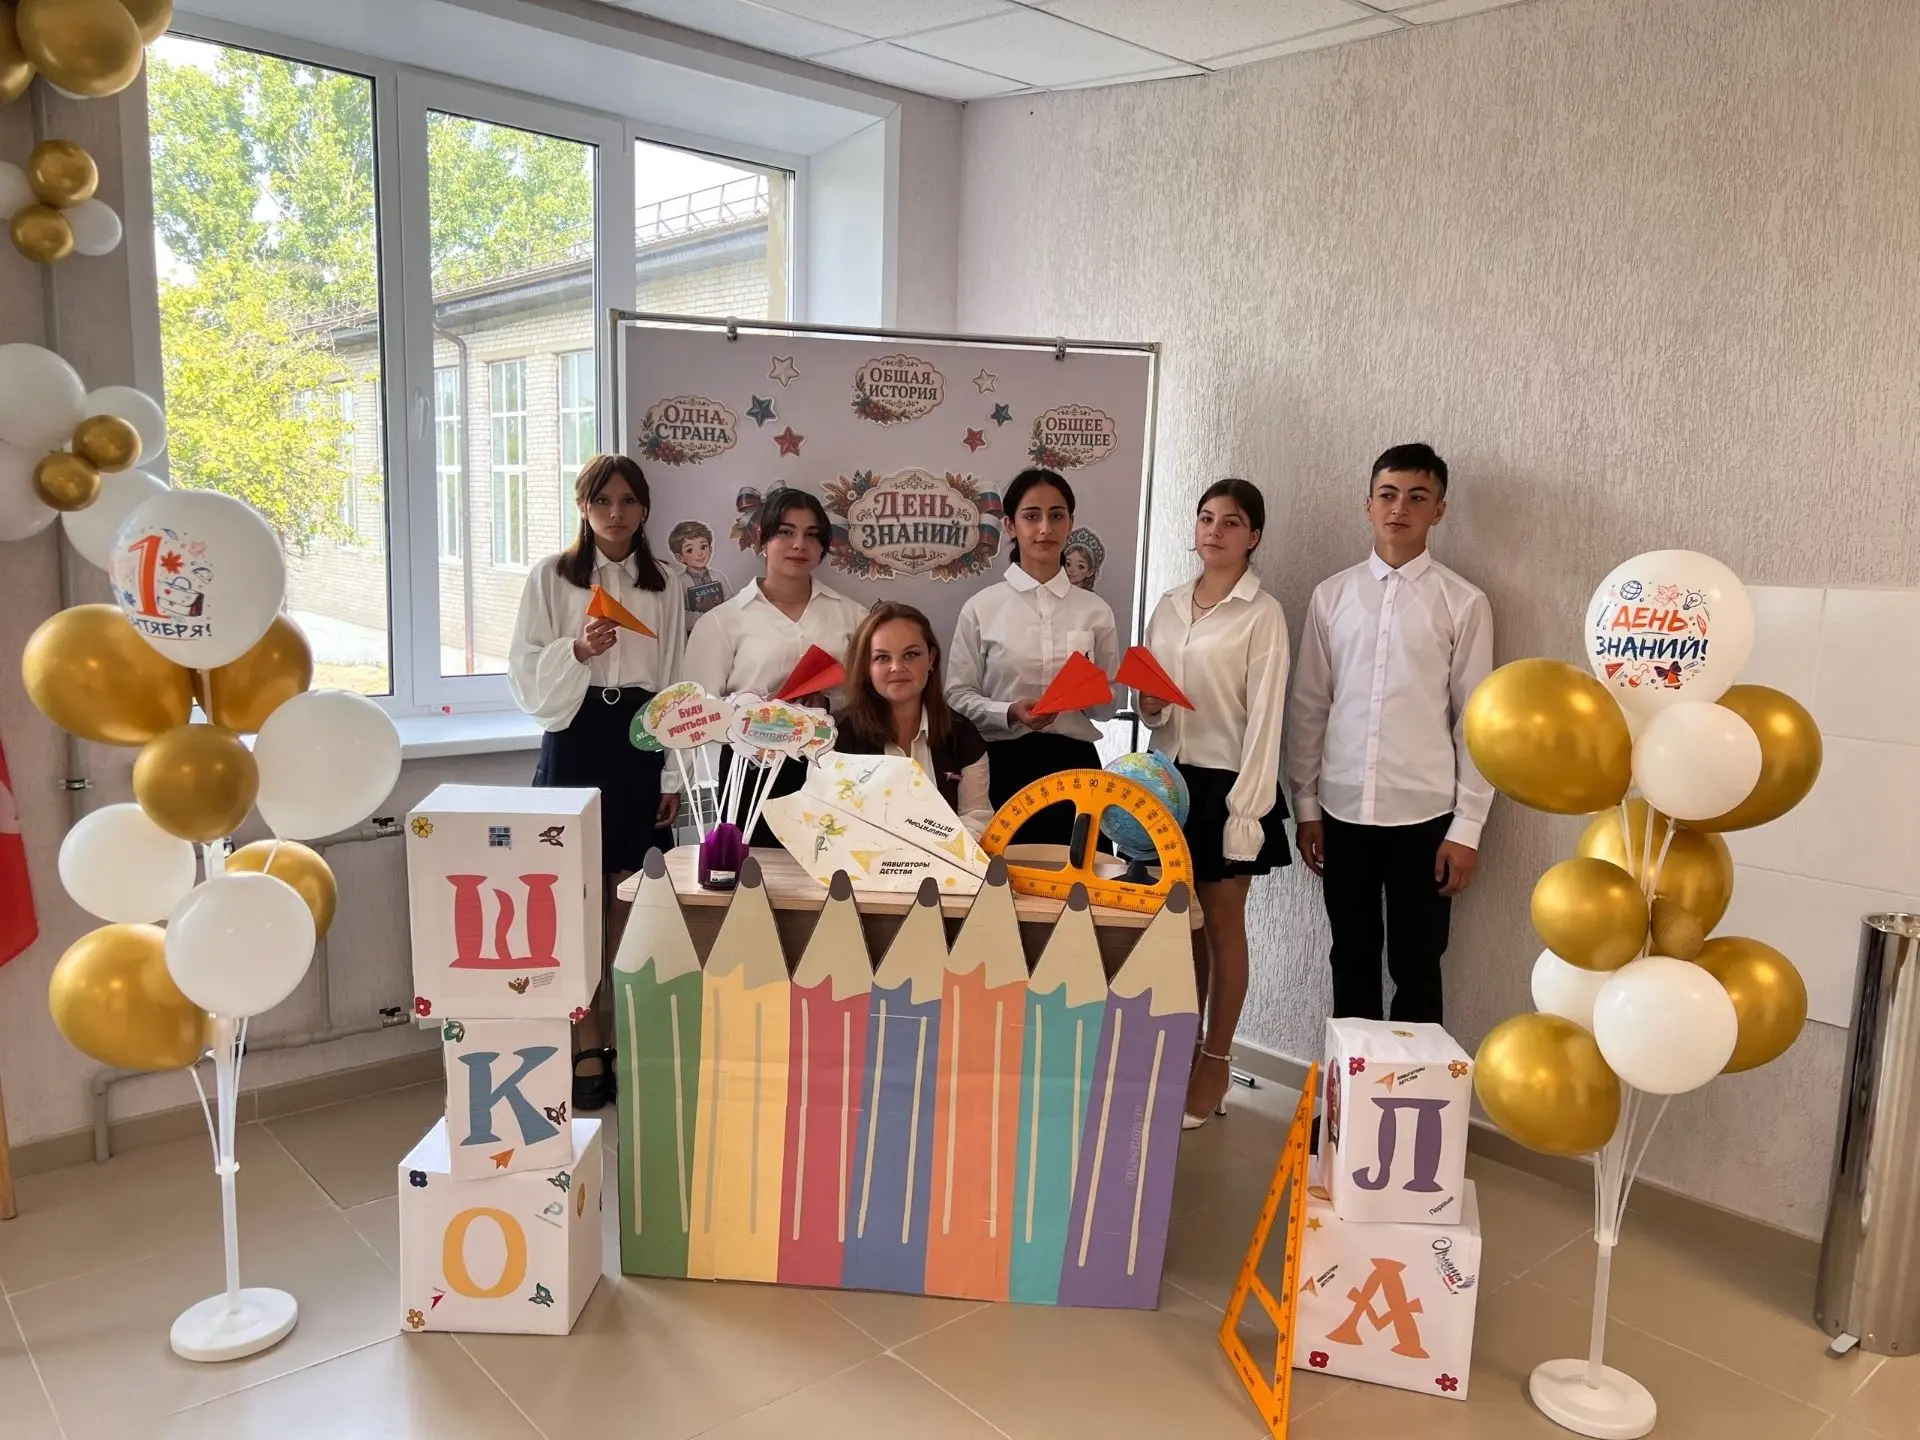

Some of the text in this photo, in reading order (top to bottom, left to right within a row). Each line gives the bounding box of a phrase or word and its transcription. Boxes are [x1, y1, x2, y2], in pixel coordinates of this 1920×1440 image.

[870, 367, 934, 385] ОБЩАЯ
[869, 384, 937, 400] ИСТОРИЯ
[663, 405, 727, 425] ОДНА
[1046, 417, 1103, 433] ОБЩЕЕ
[655, 423, 732, 443] СТРАНА
[1045, 433, 1110, 447] БУДУЩЕЕ
[873, 491, 955, 522] ДЕНЬ
[862, 520, 969, 548] ЗНАНИЙ!
[127, 534, 171, 619] 1
[1611, 605, 1689, 632] ДЕНЬ
[1596, 635, 1708, 661] ЗНАНИЙ!
[667, 717, 709, 738] учиться
[708, 712, 721, 723] на
[689, 731, 706, 743] 10+
[748, 730, 802, 742] сентября
[1089, 778, 1098, 788] 90
[923, 818, 955, 833] ДЕТСТВА
[445, 873, 560, 969] Ш
[457, 1046, 560, 1146] К
[1352, 1097, 1451, 1191] Л
[442, 1206, 527, 1299] О
[1325, 1257, 1430, 1359] А
